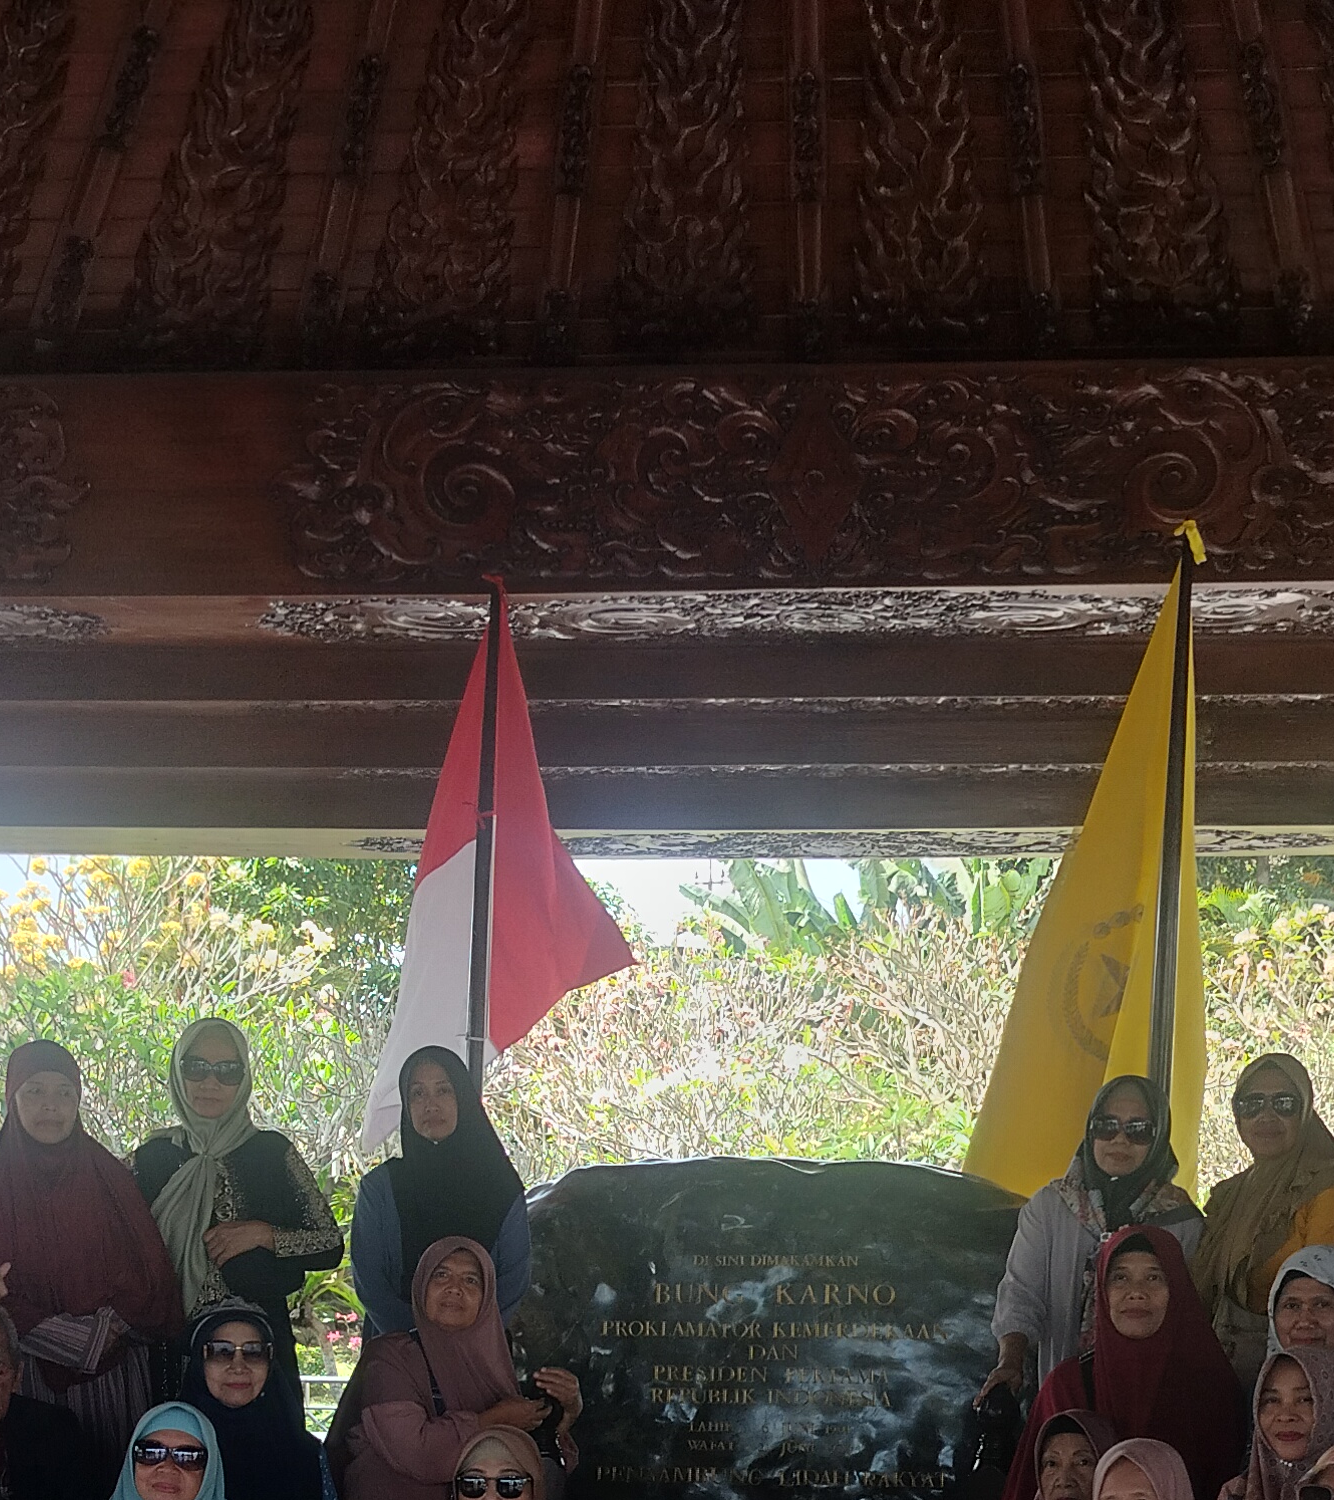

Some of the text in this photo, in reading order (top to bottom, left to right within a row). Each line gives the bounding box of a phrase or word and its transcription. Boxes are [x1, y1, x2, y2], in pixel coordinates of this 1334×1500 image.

[693, 1255, 860, 1268] DI SINI DIMAKAMKAN
[655, 1282, 897, 1306] BUNG KARNO
[601, 1320, 762, 1338] PROKLAMATOR
[748, 1344, 798, 1361] DAN
[653, 1365, 767, 1383] PRESIDEN
[651, 1388, 755, 1404] REPUBLIK
